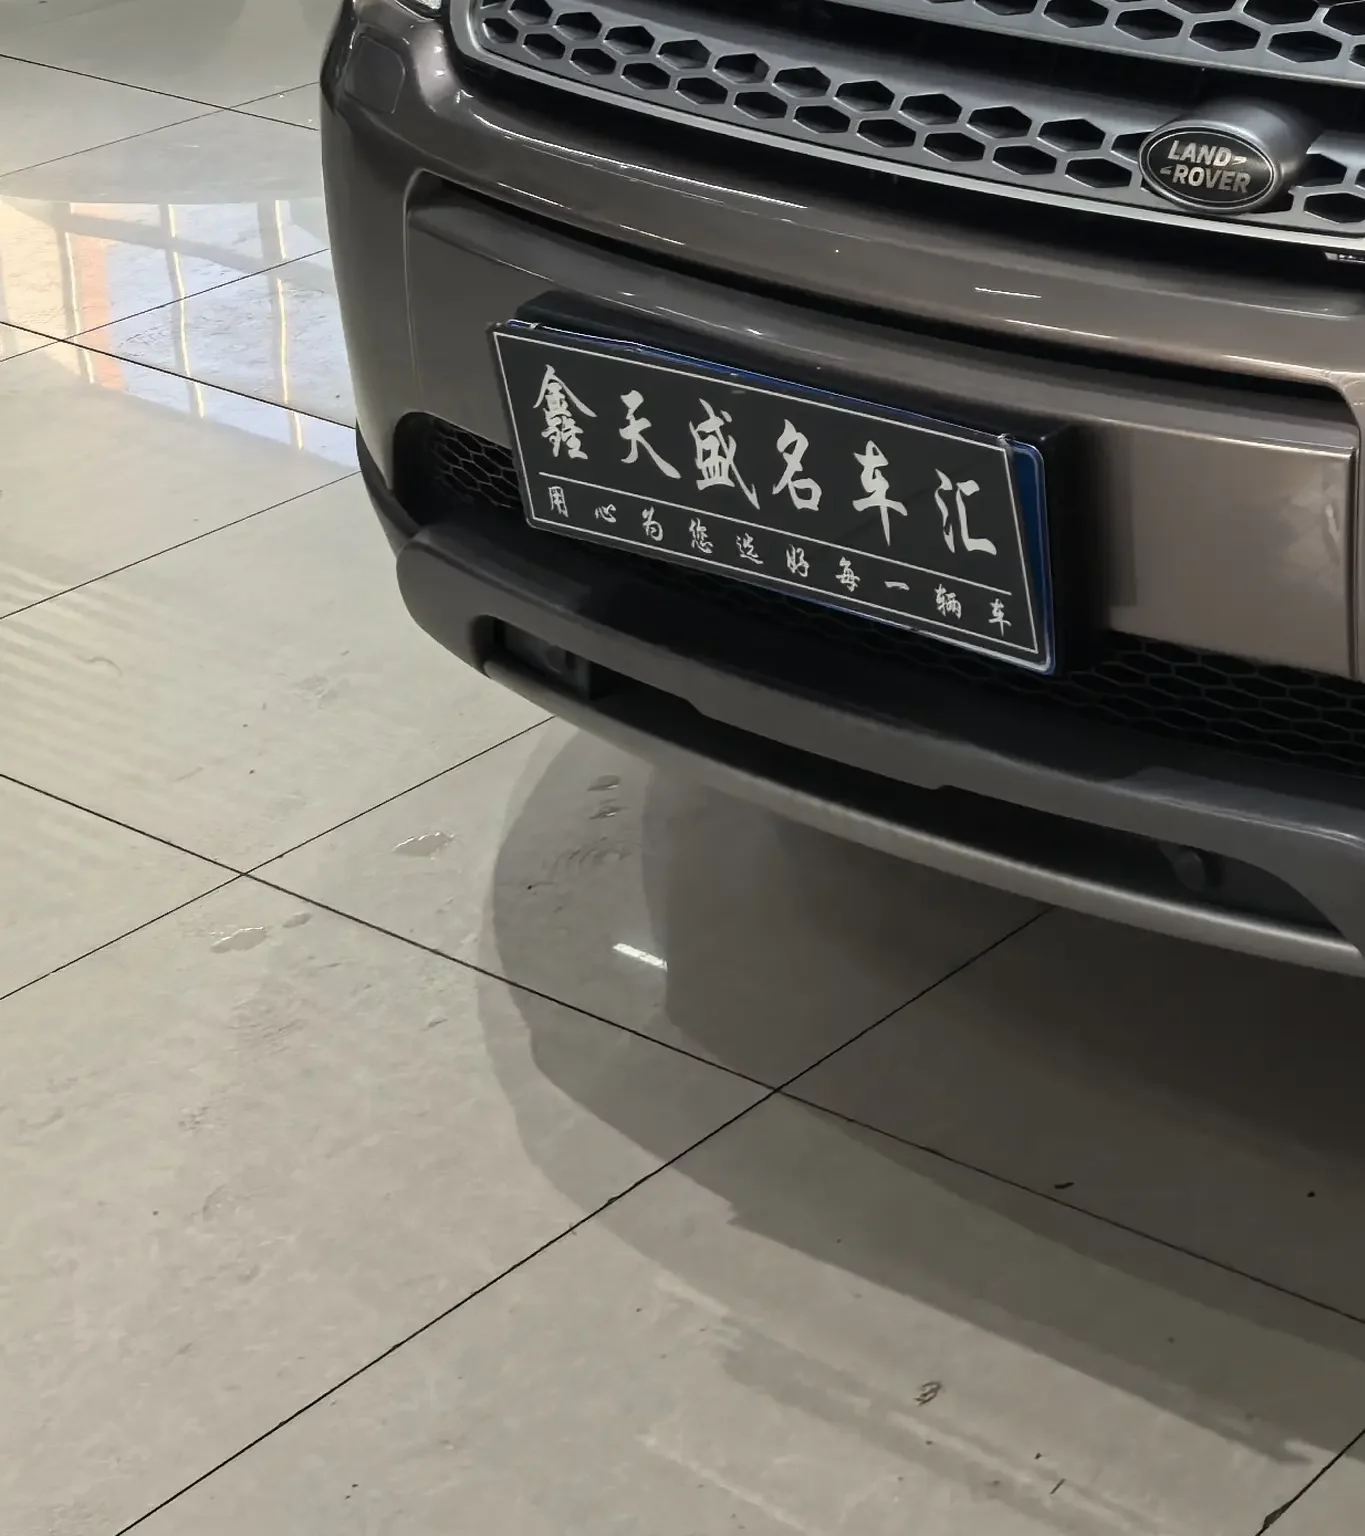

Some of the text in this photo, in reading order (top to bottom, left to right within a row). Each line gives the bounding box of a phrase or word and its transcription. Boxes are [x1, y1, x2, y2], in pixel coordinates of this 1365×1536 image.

[1168, 140, 1233, 167] LAND
[1172, 164, 1251, 193] ROVER
[533, 365, 996, 555] 鑫天盛名车汇
[548, 486, 1012, 636] 用心为您选好每一辆车
